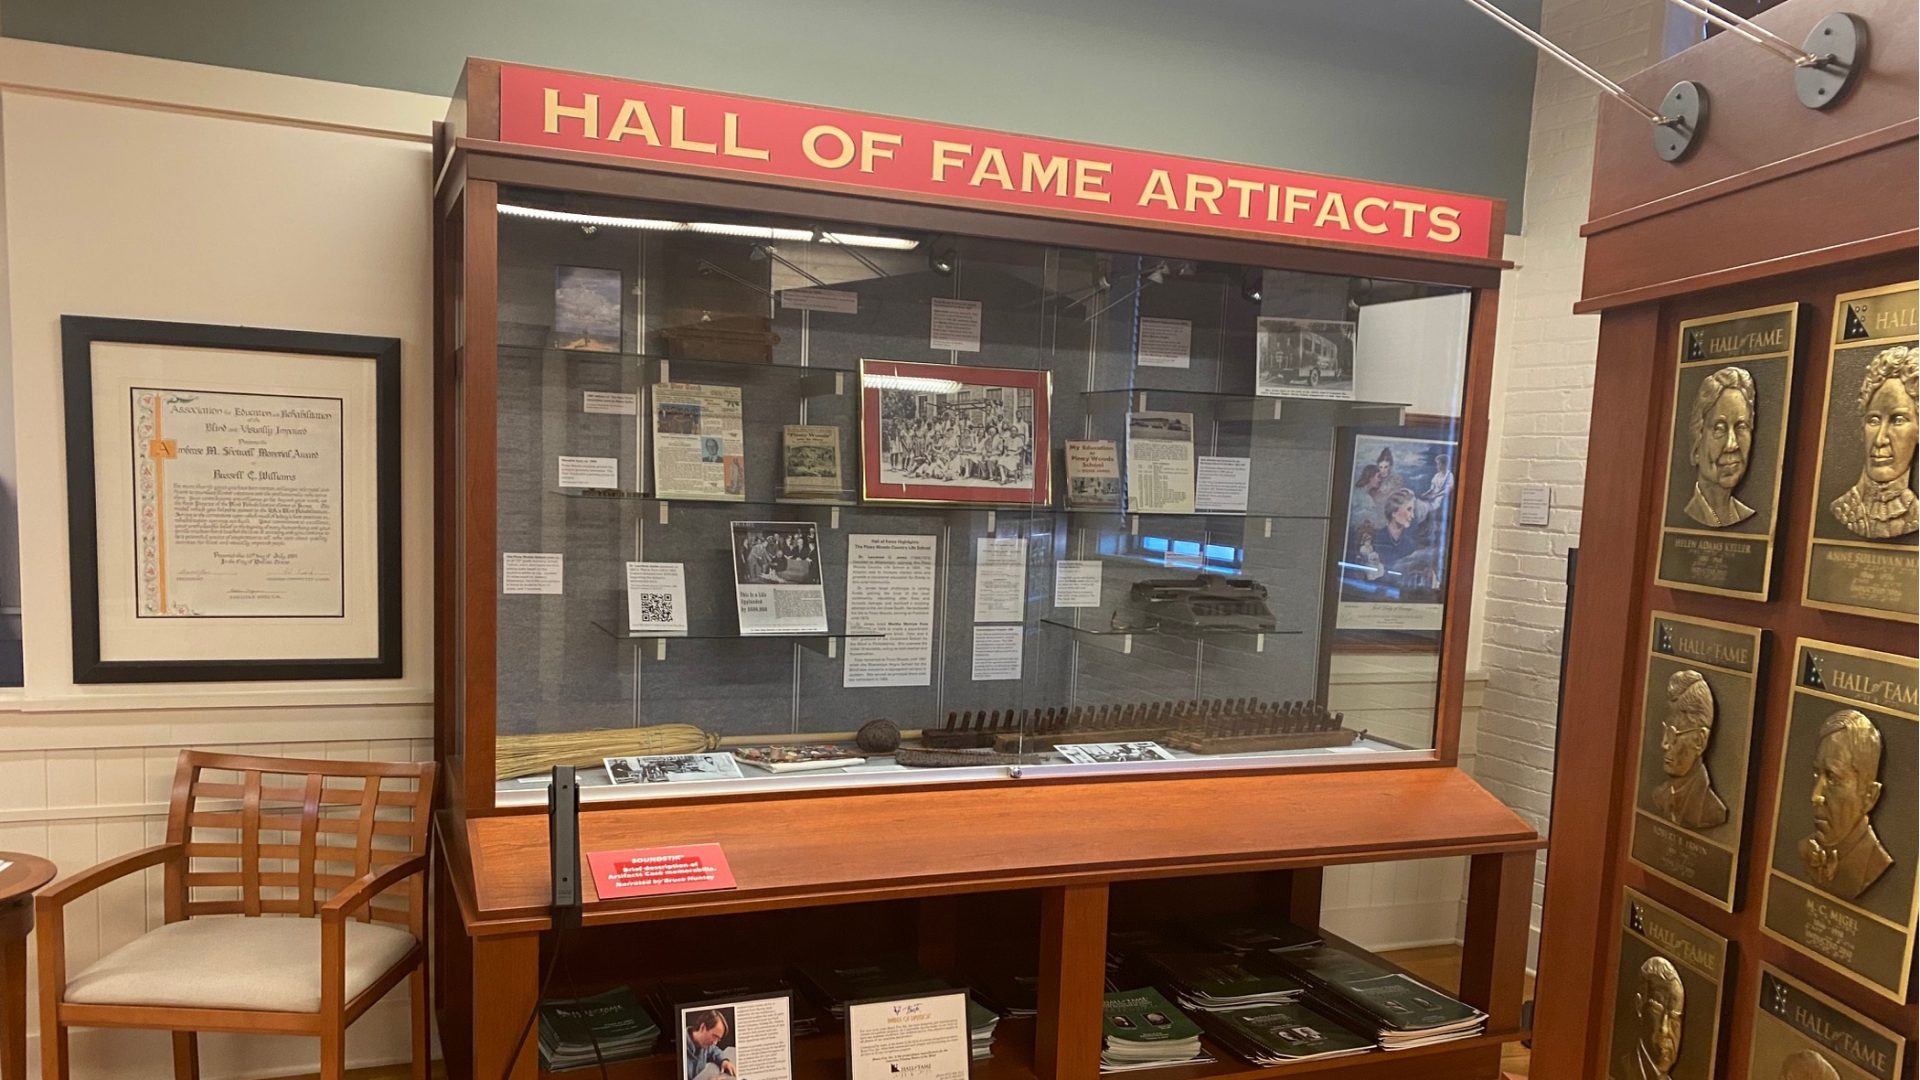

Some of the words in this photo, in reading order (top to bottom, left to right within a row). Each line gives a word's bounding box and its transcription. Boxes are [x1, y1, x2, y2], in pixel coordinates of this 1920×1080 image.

[543, 87, 770, 162] HALL
[801, 124, 902, 174] OF
[931, 140, 1113, 204] FAME
[1137, 169, 1463, 243] ARTIFACTS
[1875, 308, 1917, 330] HALL
[1710, 335, 1738, 354] HALL
[1748, 328, 1784, 349] FAME
[170, 404, 222, 416] Association
[205, 423, 227, 433] Blind
[241, 424, 273, 436] Visually
[213, 469, 244, 480] Russell
[259, 470, 297, 482] Williams
[1675, 538, 1697, 548] HELEN
[1725, 543, 1751, 553] KELLER
[1855, 553, 1903, 567] SULLIVAN
[1679, 637, 1705, 655] HALL
[1714, 643, 1748, 664] FAME
[1832, 670, 1872, 694] HALL
[608, 872, 643, 880] Artifacts
[644, 863, 689, 871] description
[1830, 909, 1858, 931] MIGEL
[1649, 921, 1678, 947] HALL
[1682, 941, 1715, 970] FAME
[1795, 1006, 1831, 1040] HALL
[1842, 1032, 1887, 1072] FAME
